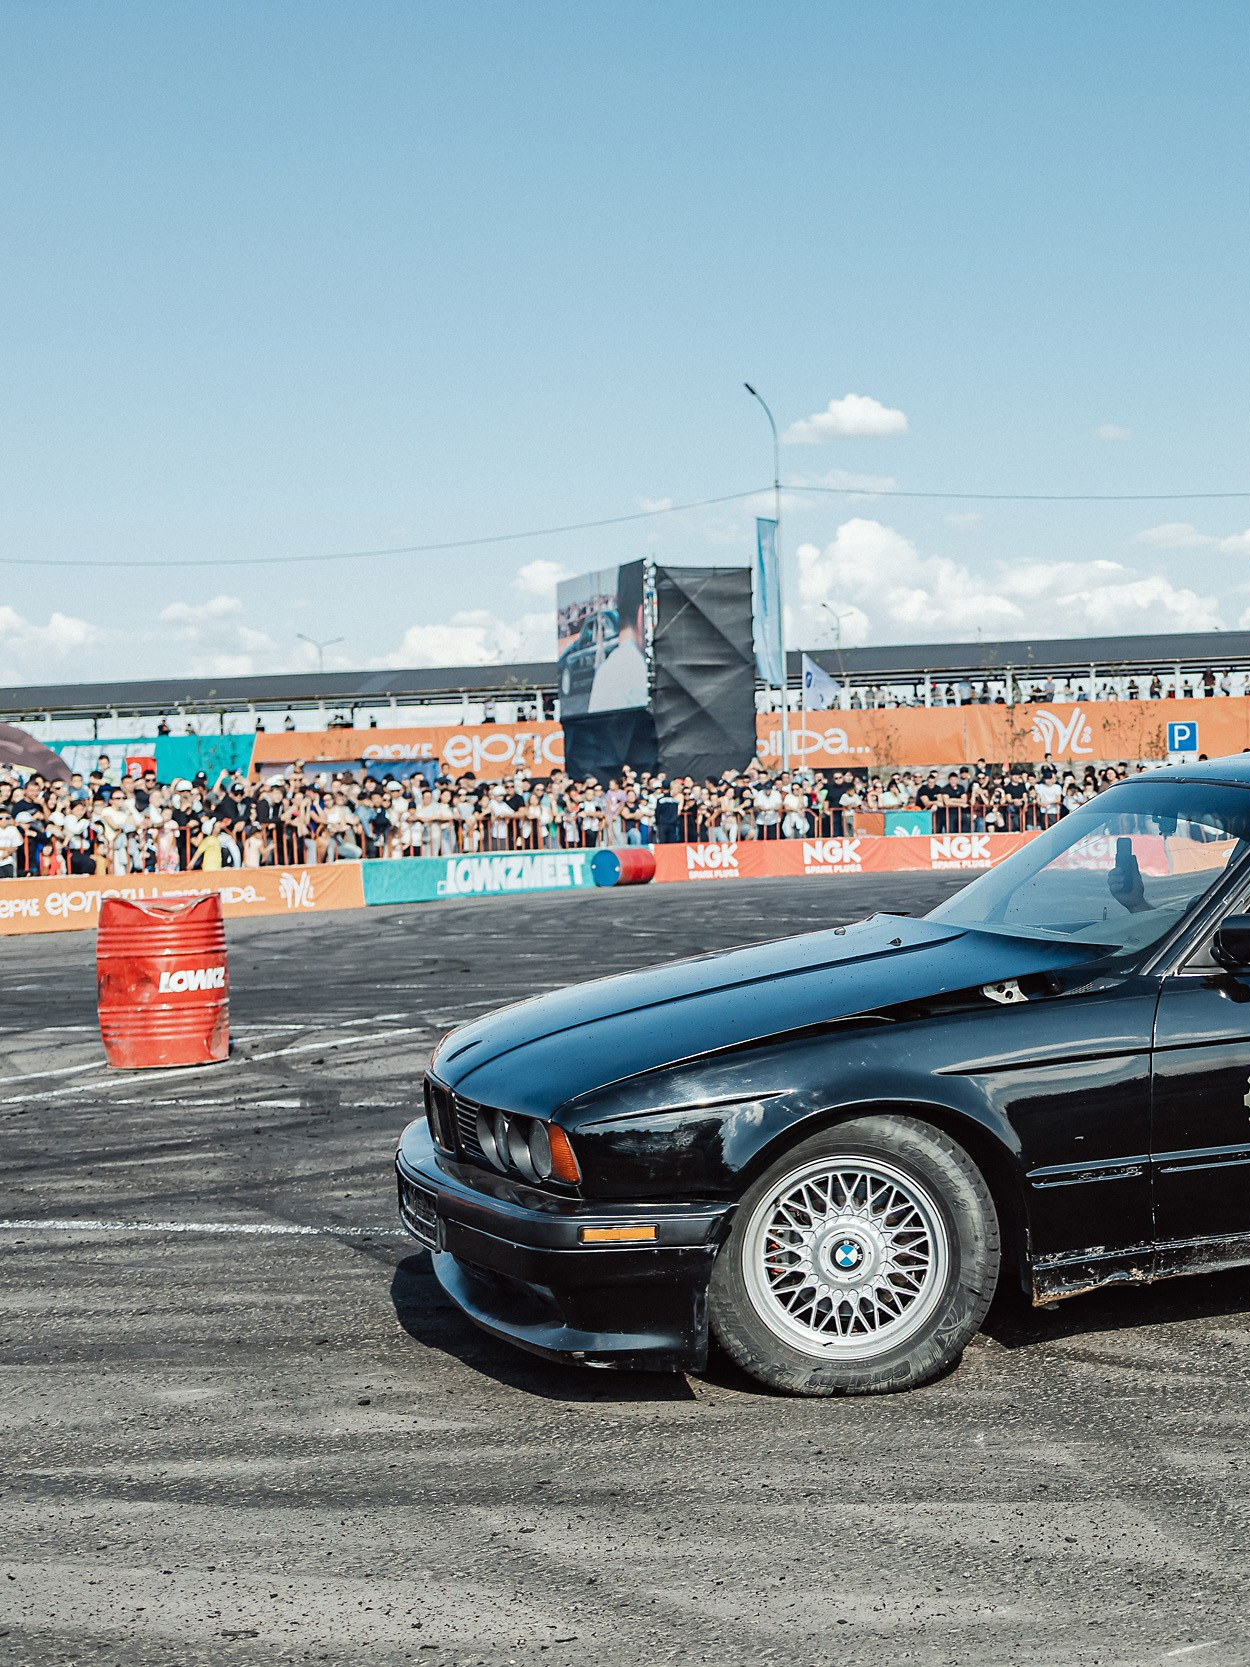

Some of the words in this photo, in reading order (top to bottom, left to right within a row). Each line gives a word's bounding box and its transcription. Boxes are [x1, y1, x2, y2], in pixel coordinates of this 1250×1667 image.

[1173, 725, 1192, 750] P
[686, 843, 738, 869] NGK
[803, 839, 862, 864] NGK
[930, 836, 991, 860] NGK
